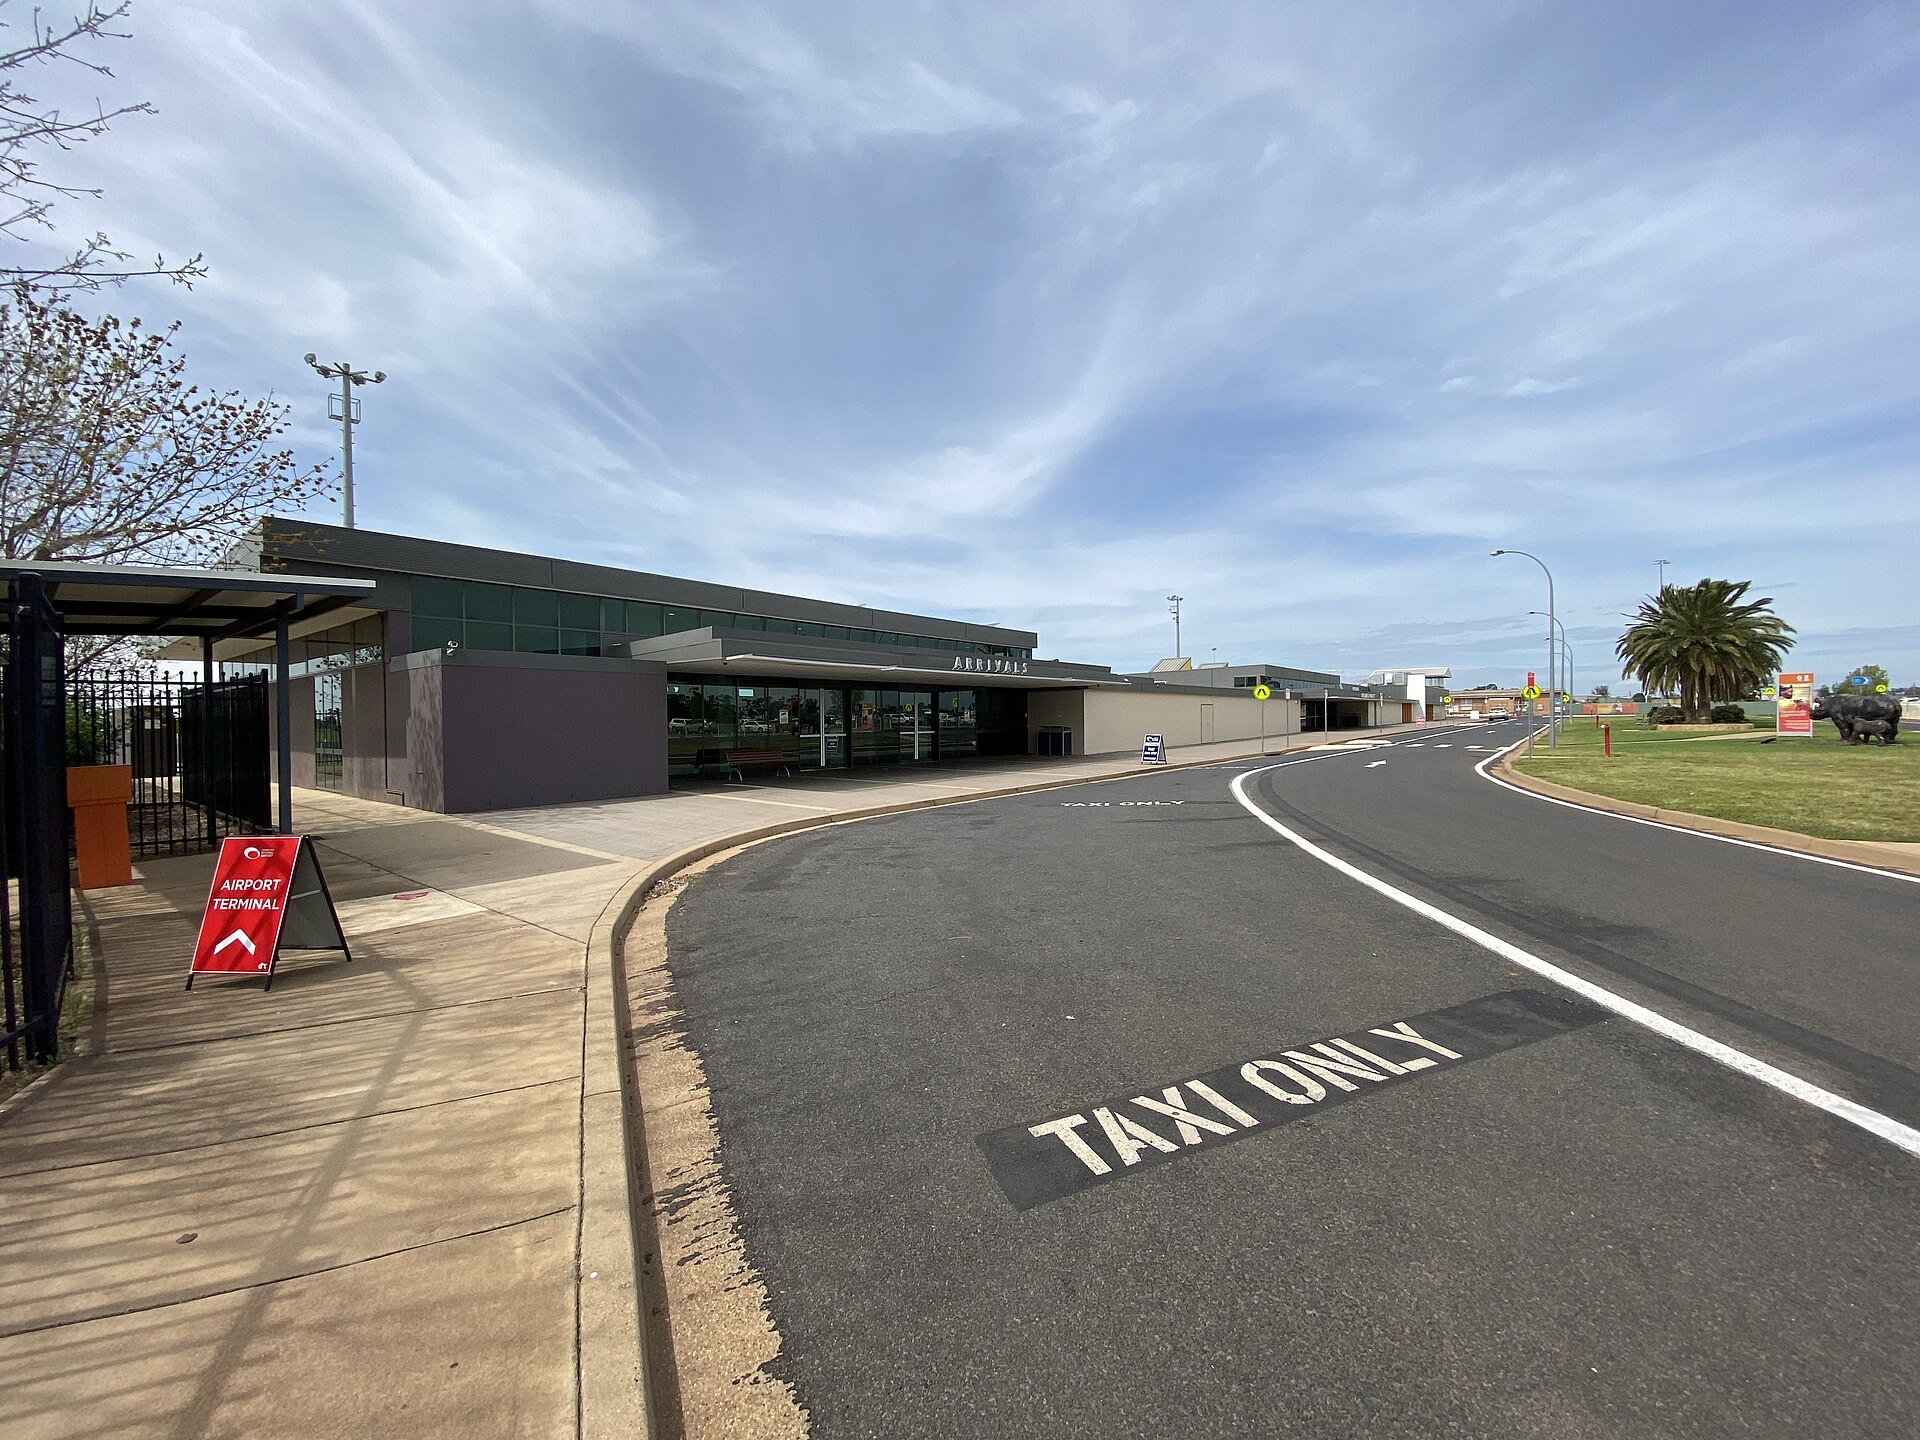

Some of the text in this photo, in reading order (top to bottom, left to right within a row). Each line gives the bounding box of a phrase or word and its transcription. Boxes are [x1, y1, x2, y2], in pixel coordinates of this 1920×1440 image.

[951, 656, 1028, 674] ARRIVALS
[220, 878, 282, 891] AIRPORT
[213, 898, 280, 910] TERMINAL
[1027, 1021, 1464, 1176] TAXI ONLY
